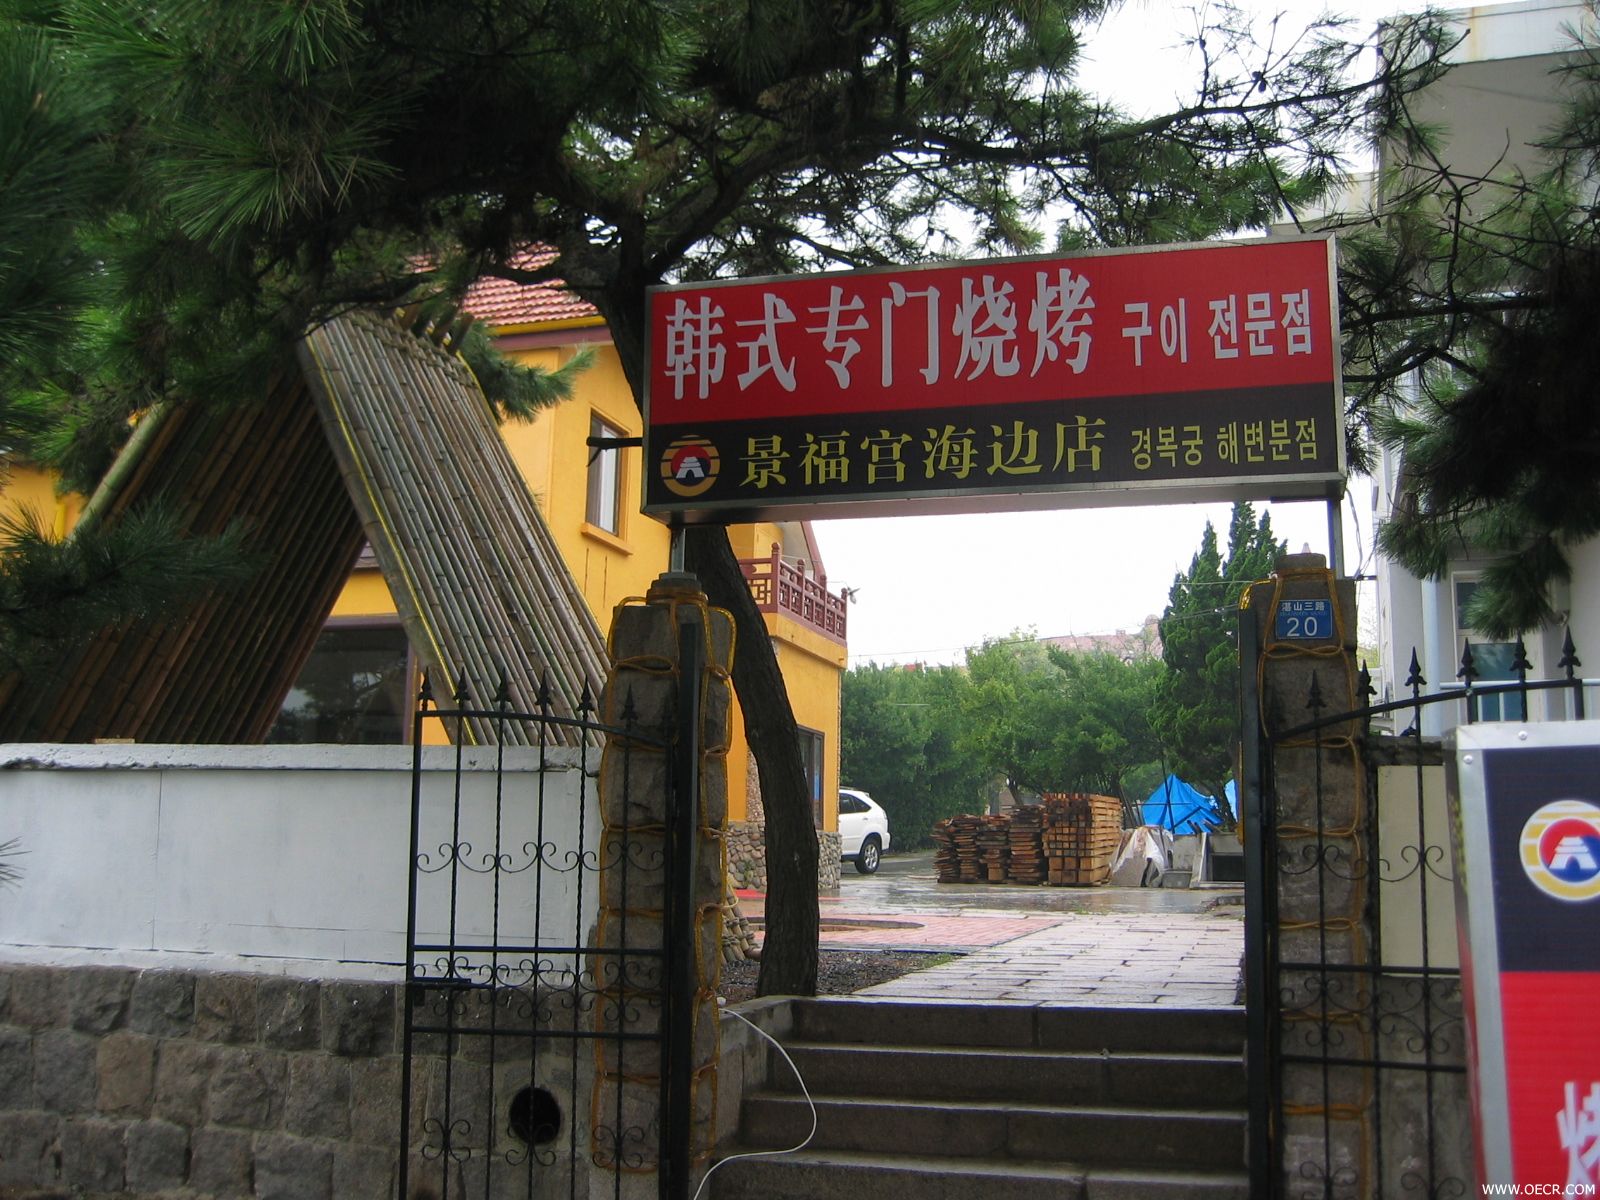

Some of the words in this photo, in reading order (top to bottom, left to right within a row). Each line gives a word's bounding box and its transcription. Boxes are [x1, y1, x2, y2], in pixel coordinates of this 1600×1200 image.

[664, 268, 1096, 400] 韩式专门烧烤
[1121, 297, 1188, 367] 구이
[1207, 288, 1312, 360] 전문점
[738, 415, 1106, 489] 景福宫海边店
[1131, 425, 1204, 470] 경복궁
[1216, 417, 1318, 465] 해변분점
[1286, 616, 1318, 637] 20
